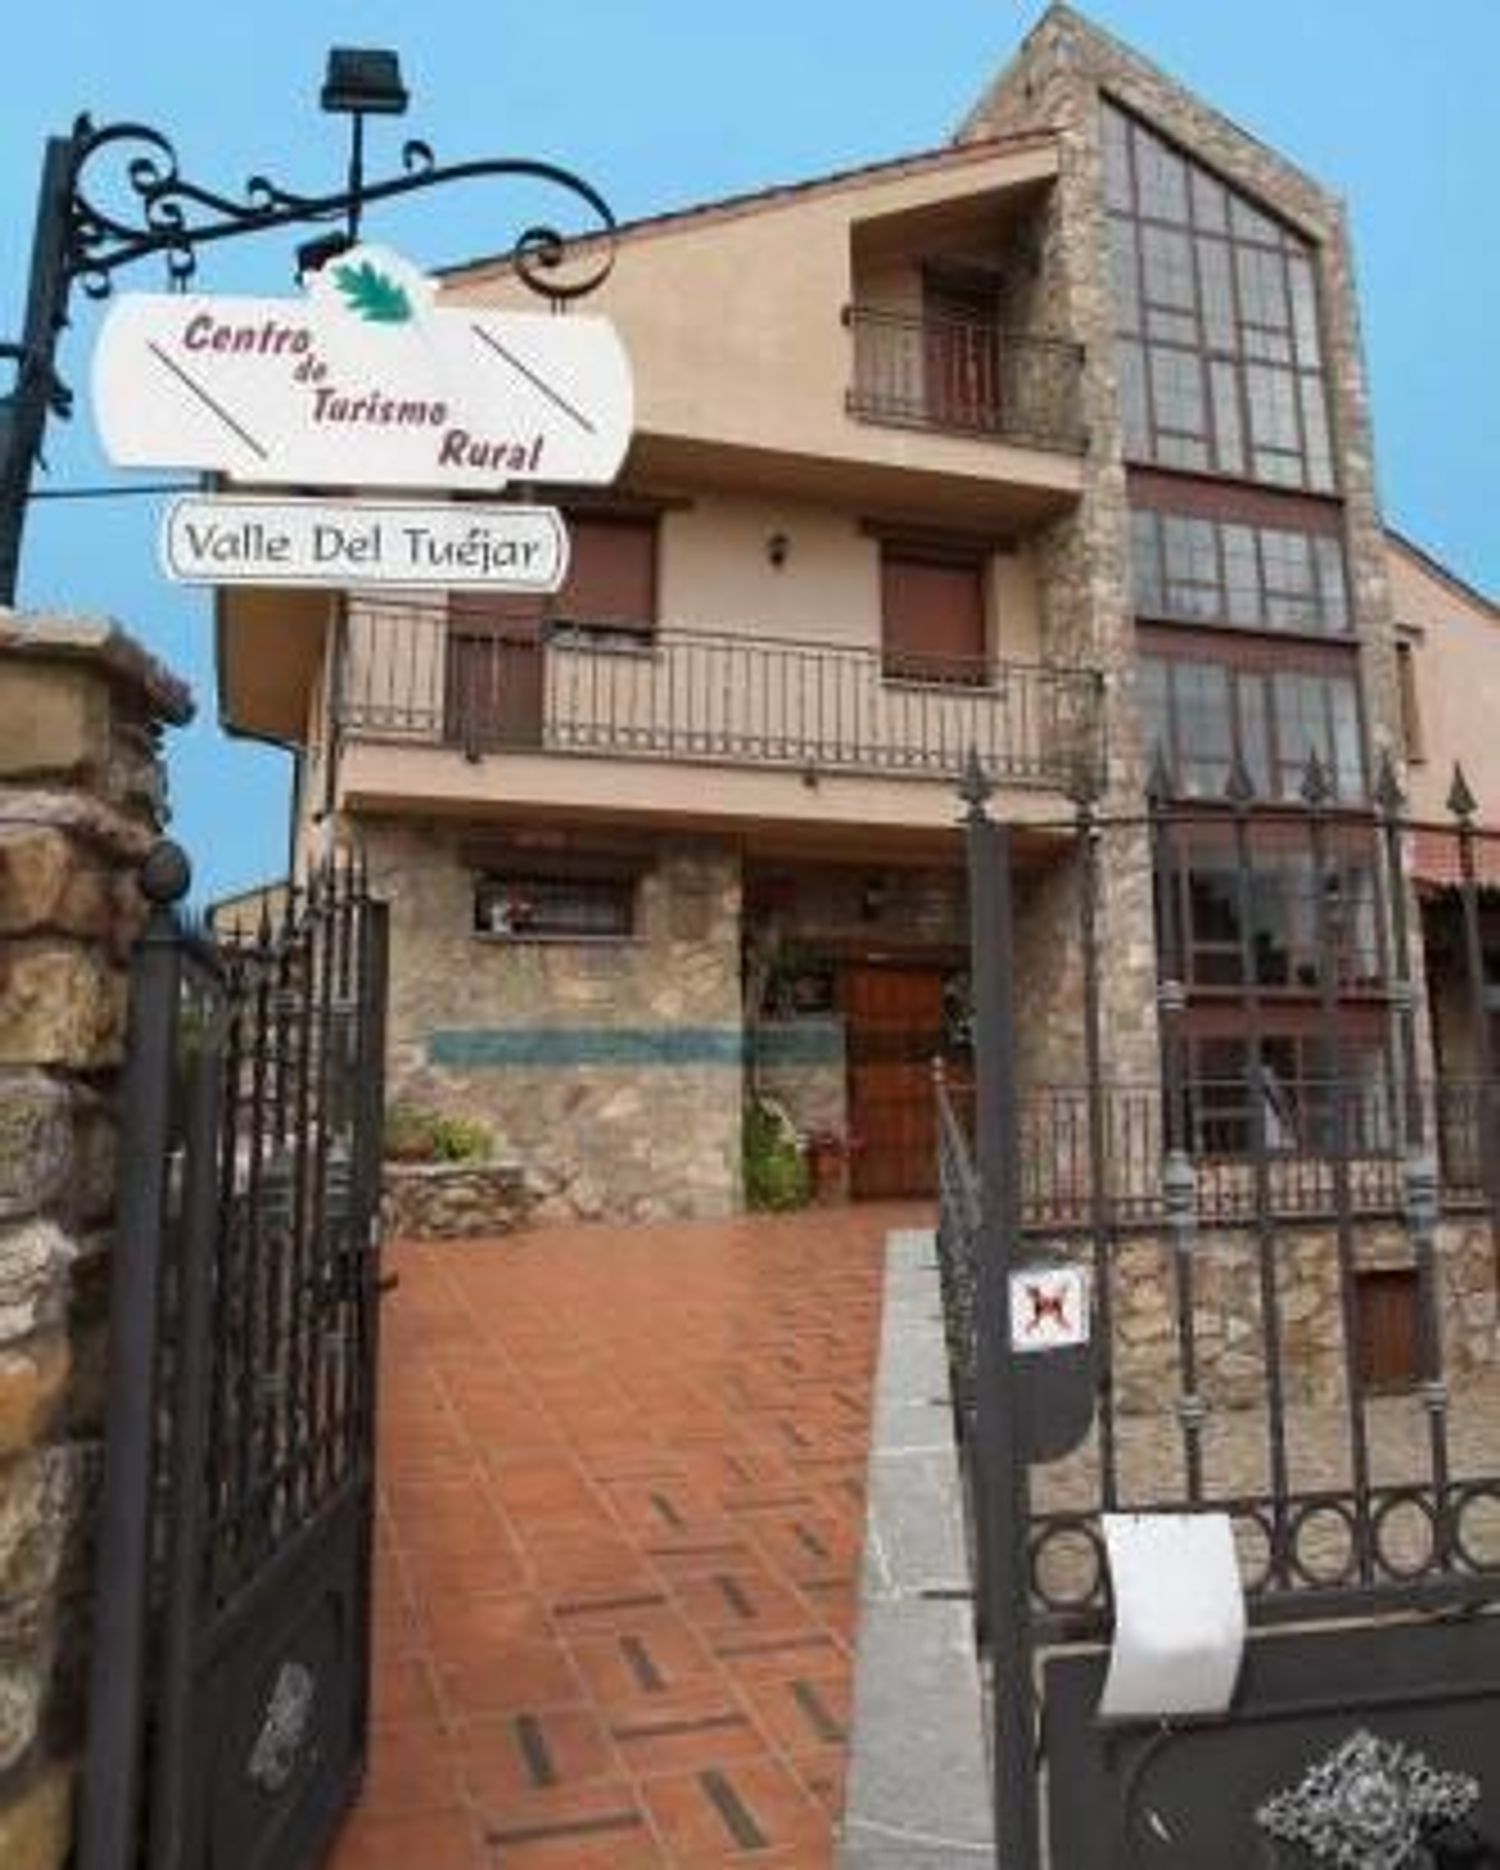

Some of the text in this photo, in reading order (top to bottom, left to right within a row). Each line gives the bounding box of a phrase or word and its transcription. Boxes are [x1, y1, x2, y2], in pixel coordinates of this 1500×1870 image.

[183, 314, 311, 355] Centro
[294, 353, 328, 383] de
[311, 387, 448, 428] Turismo
[438, 430, 544, 471] Rural
[184, 523, 542, 574] Valle Del Tuéjar
